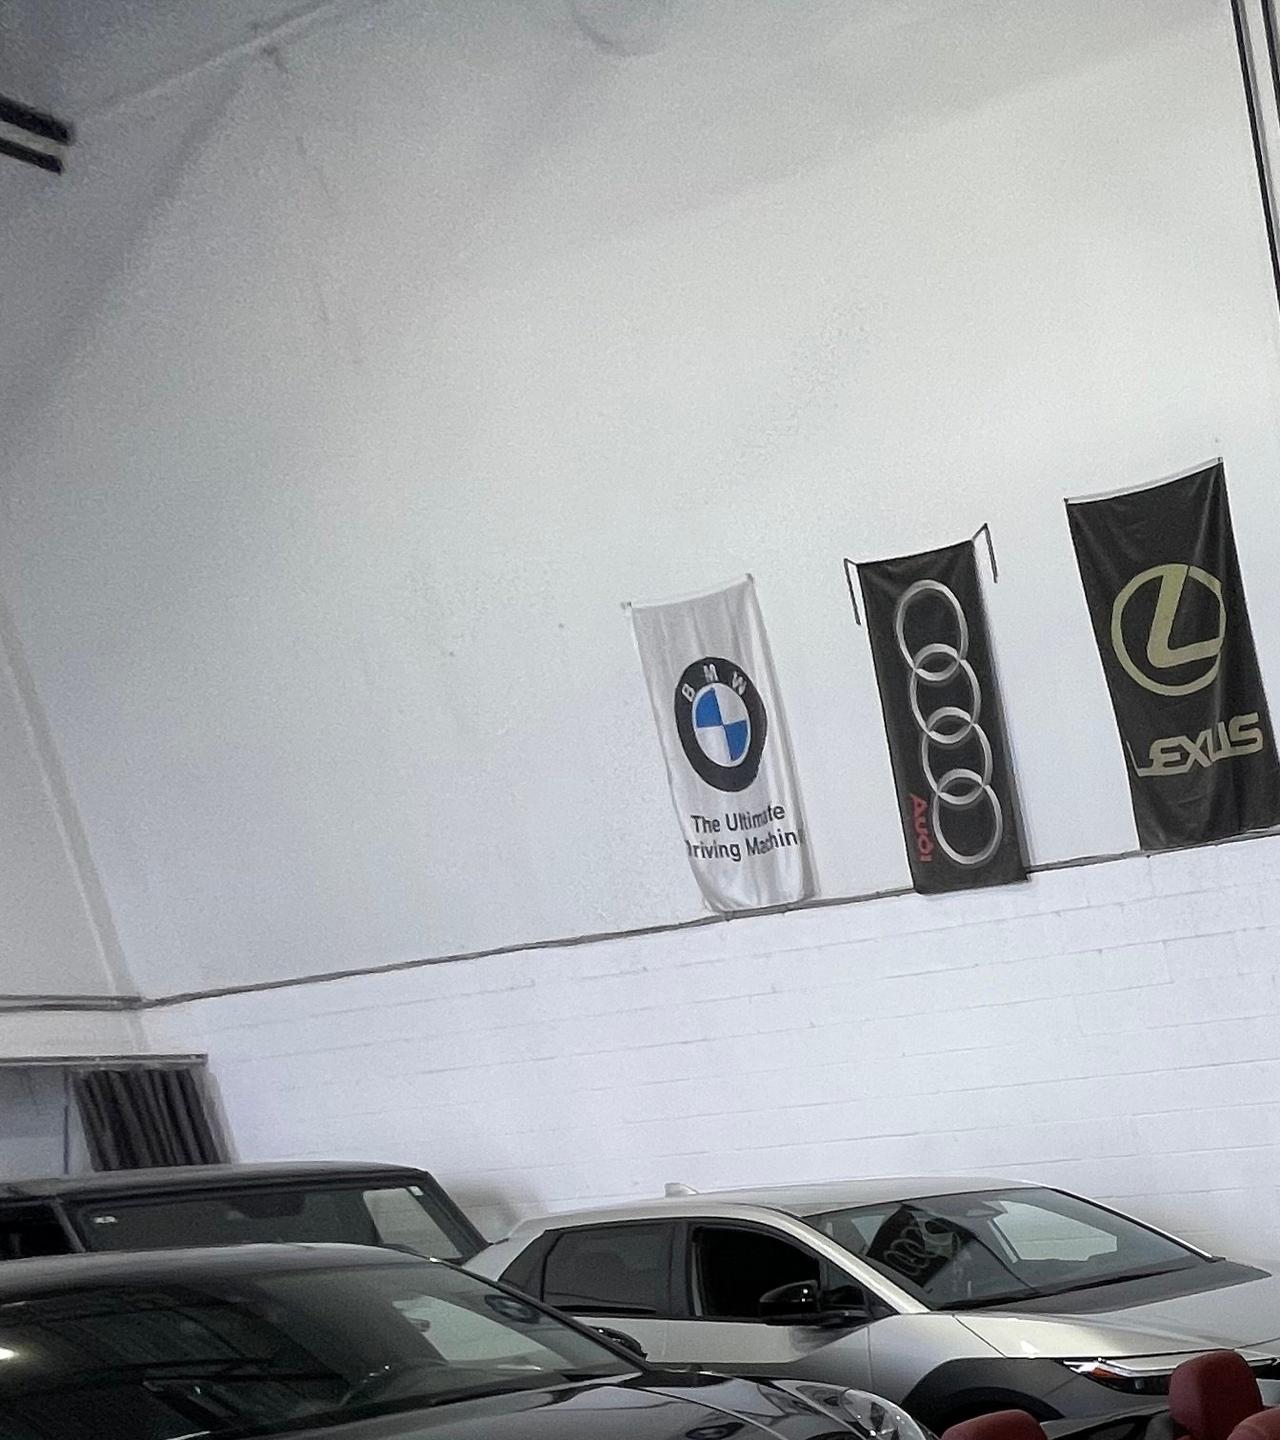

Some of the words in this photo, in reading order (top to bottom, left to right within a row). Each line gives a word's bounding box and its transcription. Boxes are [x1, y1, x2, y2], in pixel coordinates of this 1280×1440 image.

[681, 663, 747, 702] BMW
[1126, 712, 1264, 777] LEXUS
[690, 814, 721, 834] The
[725, 804, 786, 831] Ultimate
[745, 828, 804, 857] Machin
